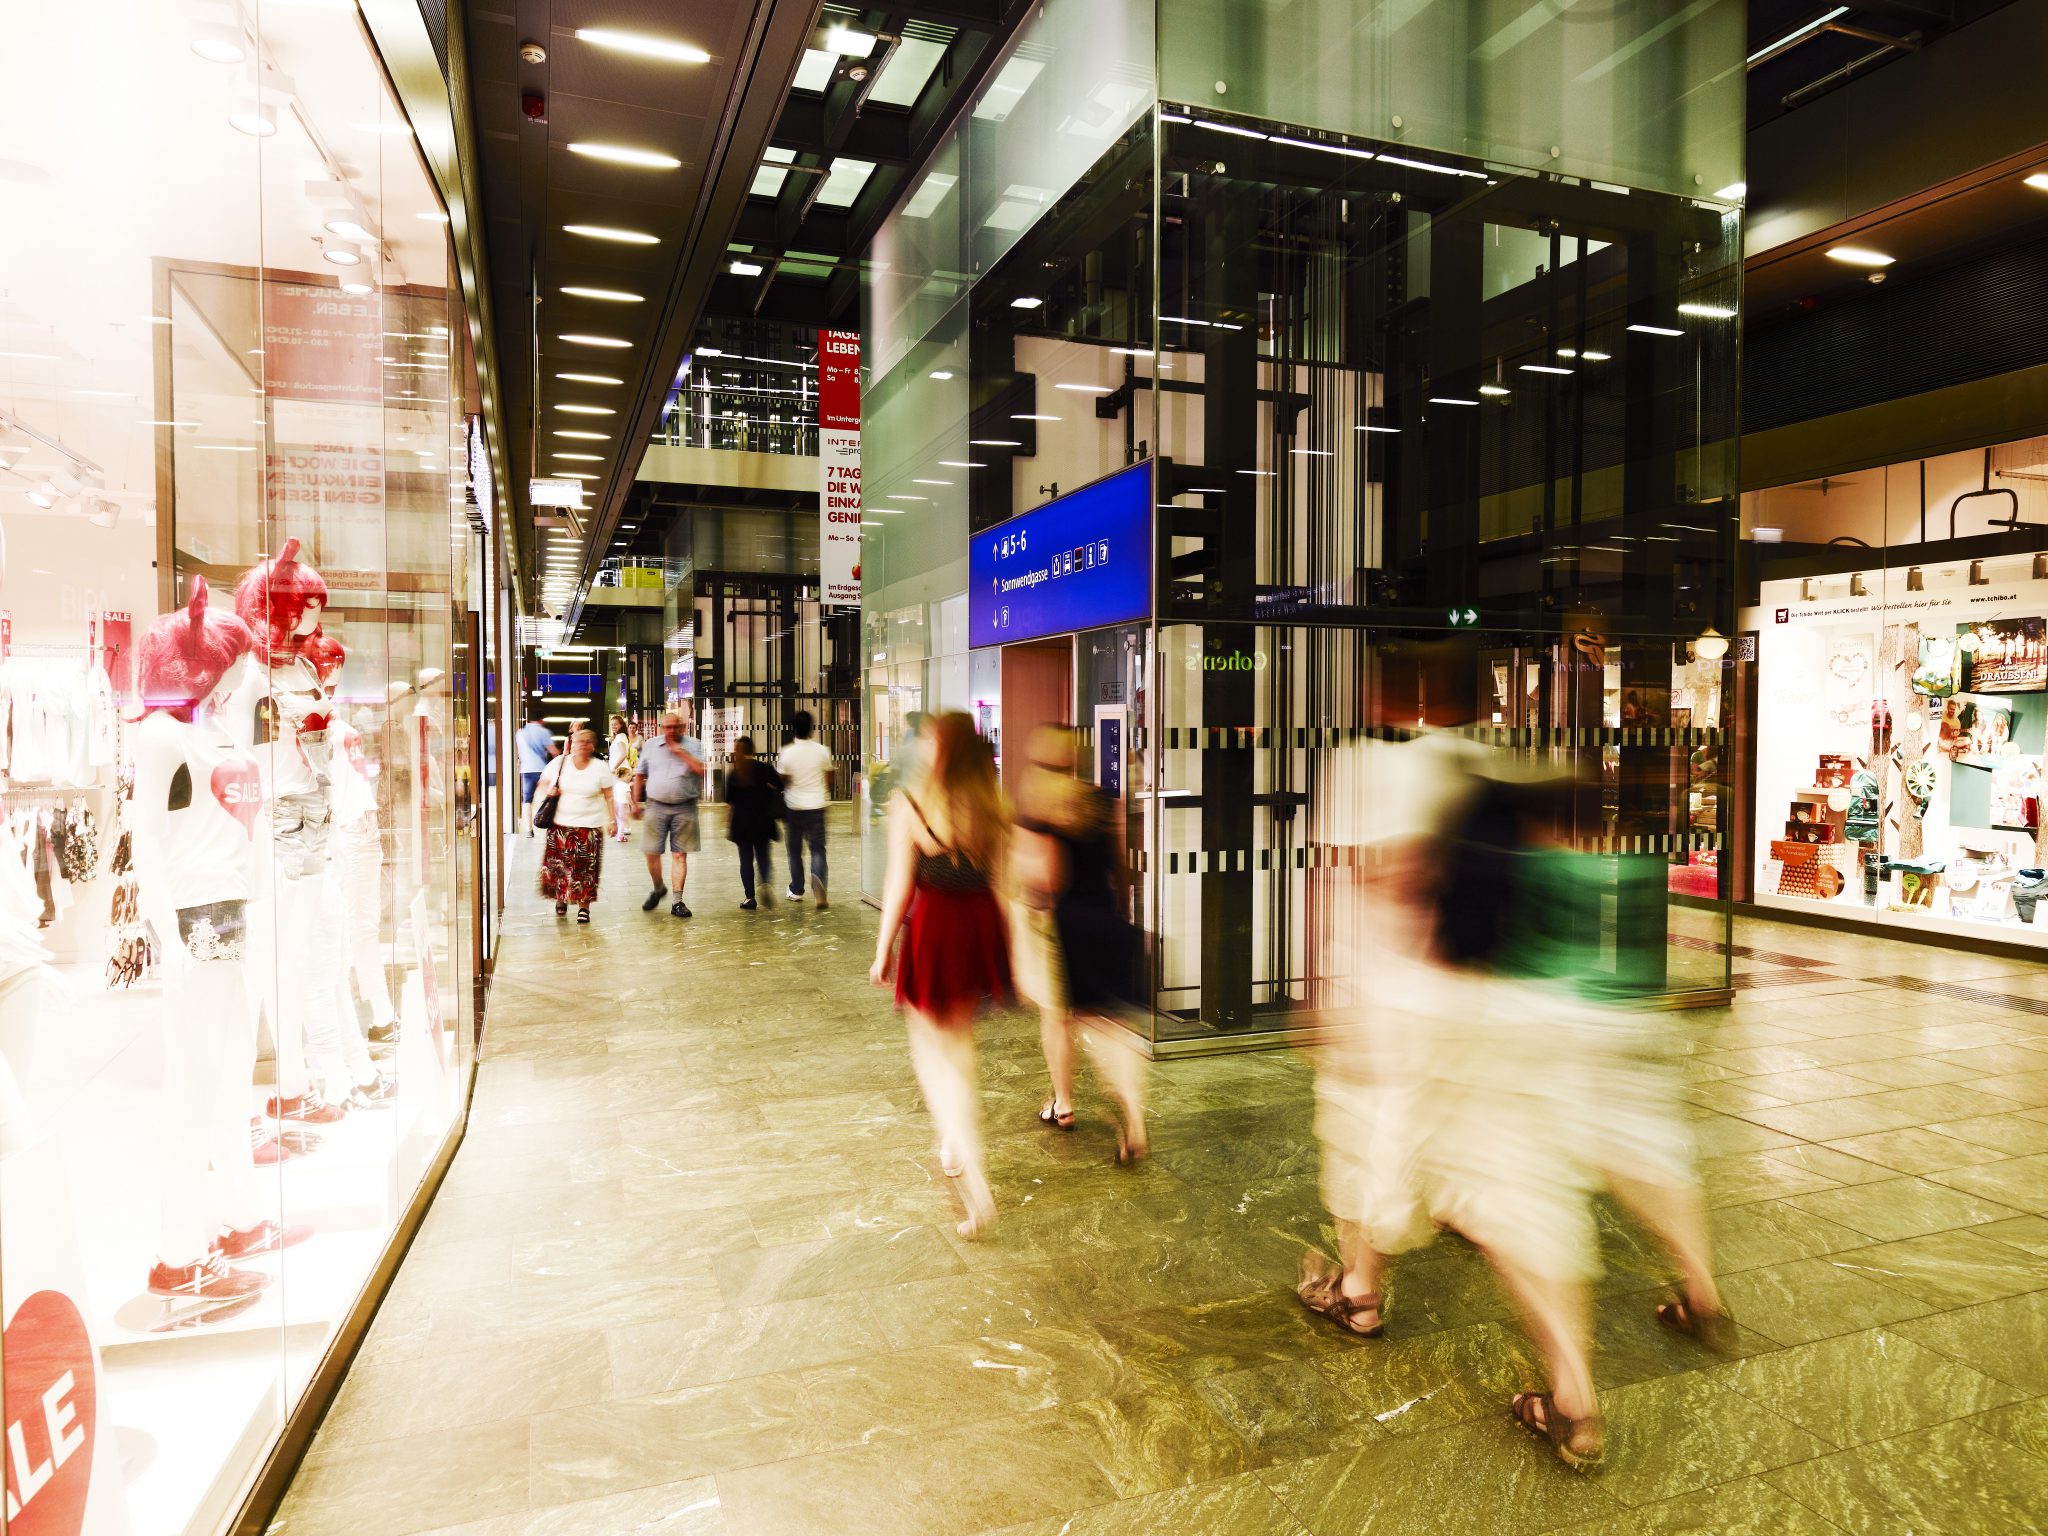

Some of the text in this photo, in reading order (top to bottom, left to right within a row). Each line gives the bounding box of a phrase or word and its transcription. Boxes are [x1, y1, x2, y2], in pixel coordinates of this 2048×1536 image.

[844, 367, 851, 375] Fr
[827, 374, 836, 382] Sa
[827, 466, 835, 478] 7
[828, 481, 847, 493] DIE
[1010, 530, 1027, 555] 5-6
[1001, 568, 1049, 593] Sonnwendgasse
[828, 591, 857, 601] Ausgang
[1970, 594, 2018, 603] www.tchibo.at
[1883, 602, 1912, 611] bestellen
[1914, 600, 1928, 608] hier
[1927, 599, 1940, 610] für
[104, 612, 131, 621] SALE
[1980, 669, 2037, 682] DRAUSSEN!
[224, 782, 260, 804] SALE
